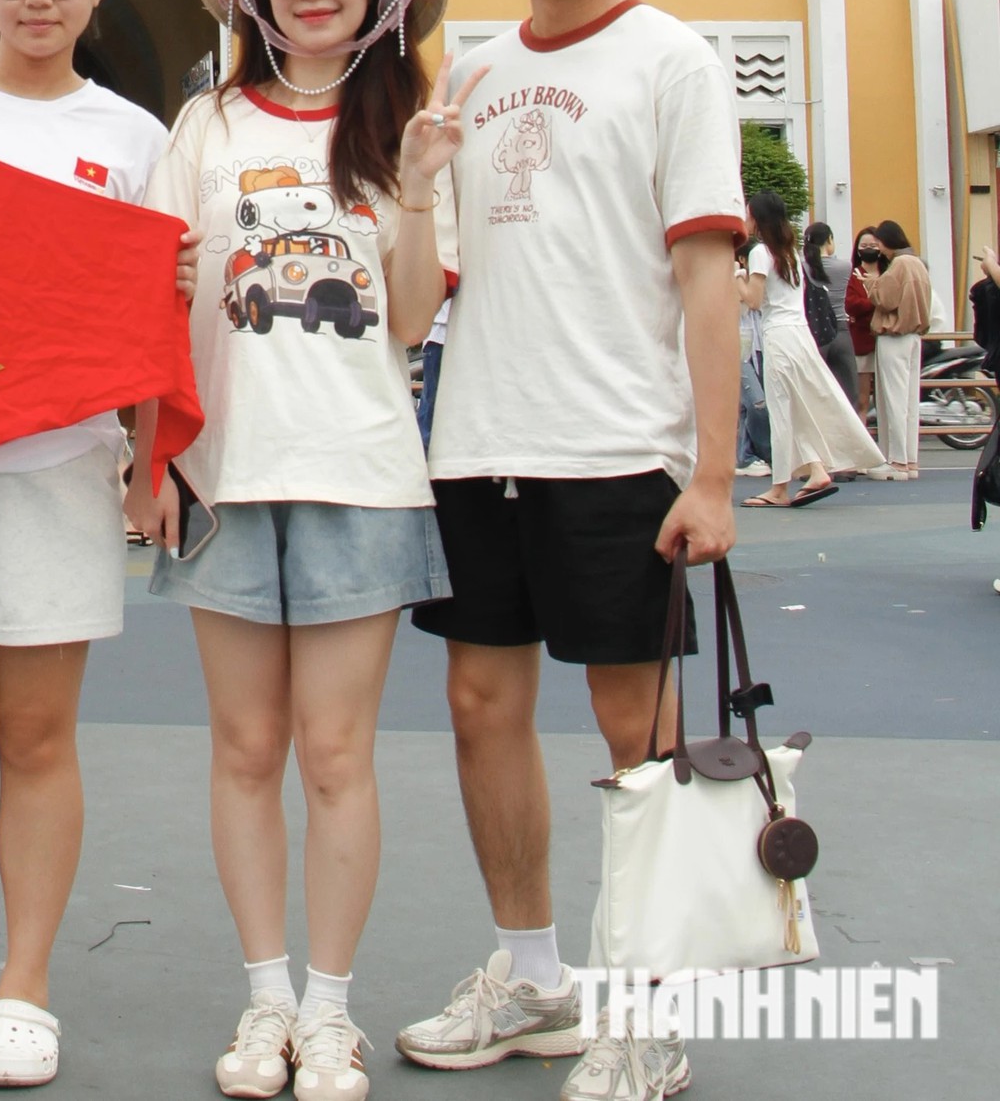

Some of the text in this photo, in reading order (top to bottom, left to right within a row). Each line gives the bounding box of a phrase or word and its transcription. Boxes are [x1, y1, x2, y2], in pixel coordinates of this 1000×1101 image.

[474, 86, 588, 130] SALLY BROWN
[522, 204, 534, 213] NO
